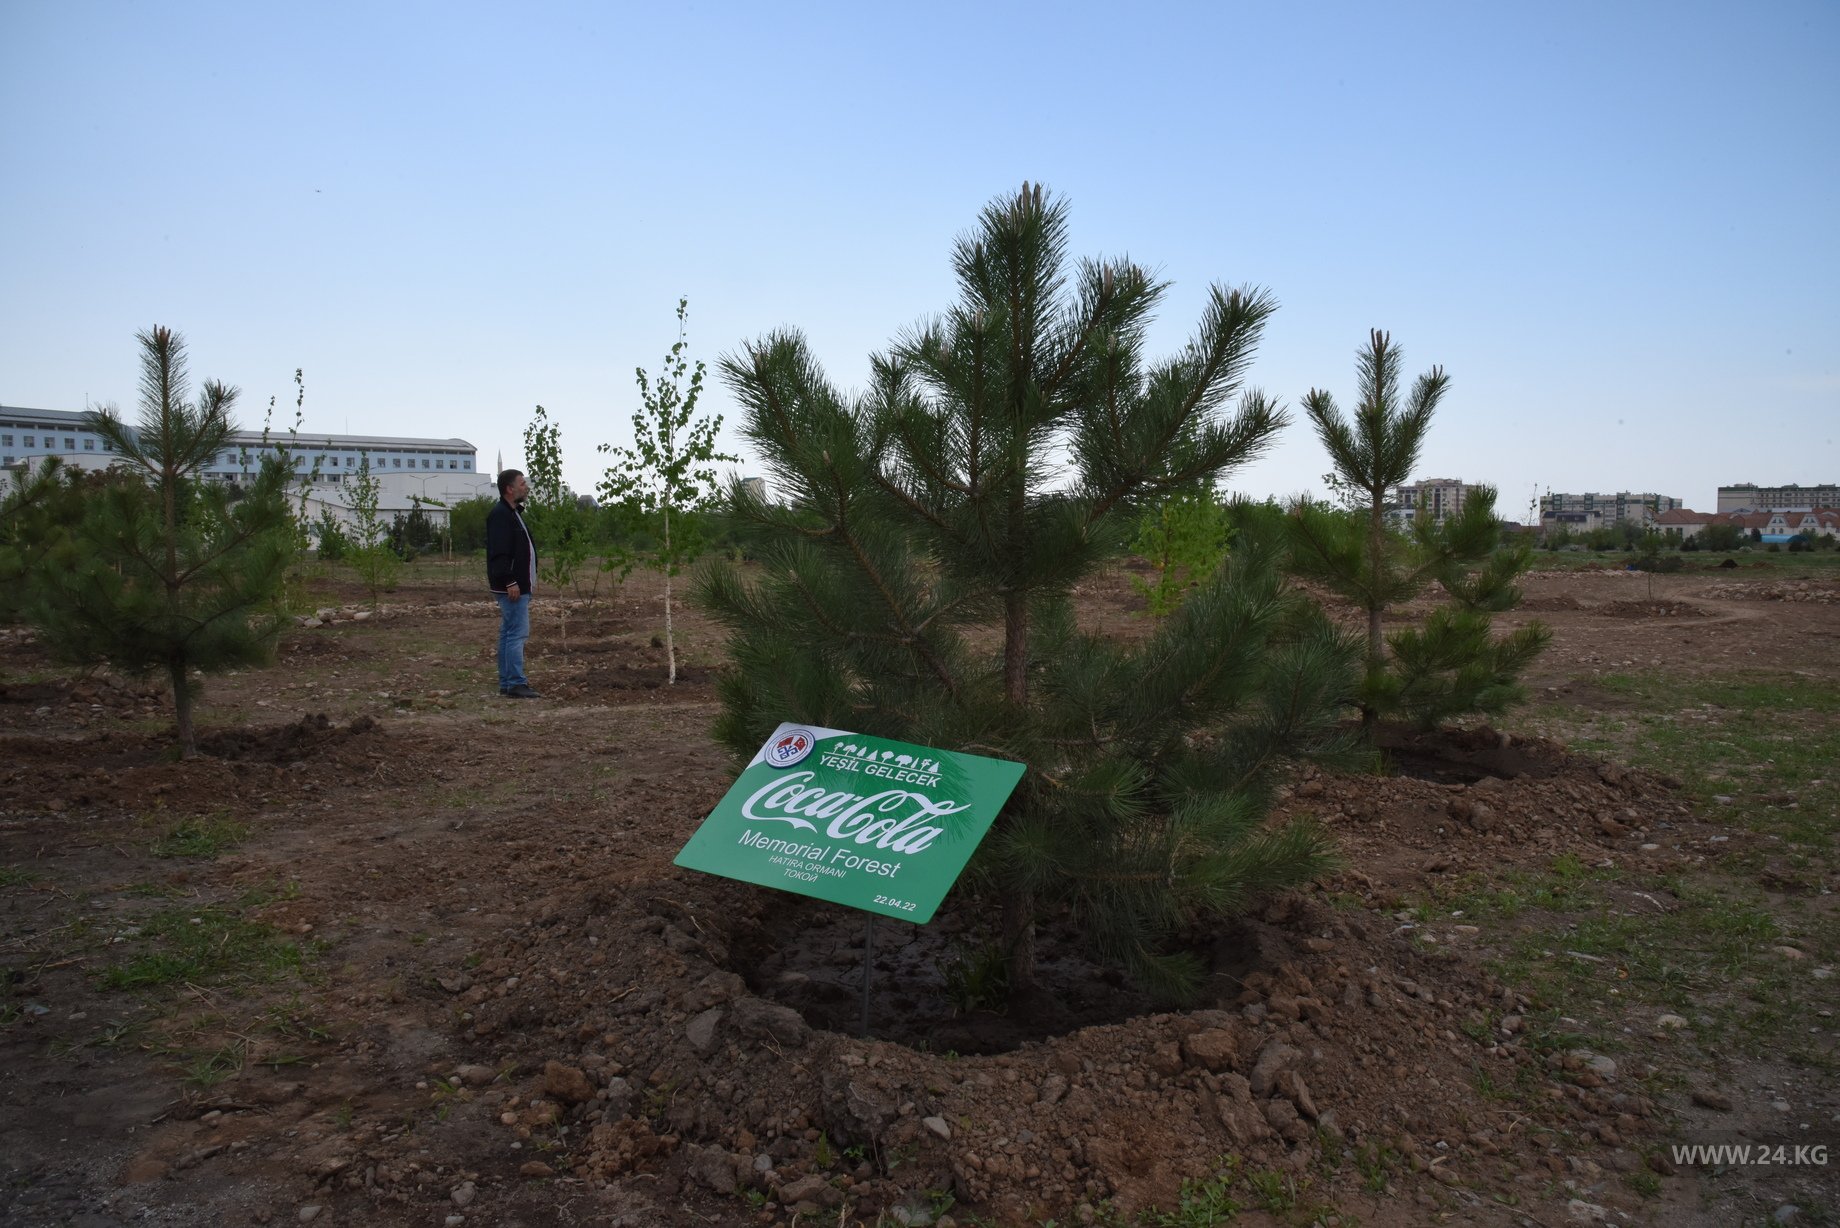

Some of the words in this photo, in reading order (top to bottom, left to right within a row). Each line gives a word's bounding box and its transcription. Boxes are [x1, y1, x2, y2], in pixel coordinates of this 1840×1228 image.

[864, 764, 943, 788] GELECEK
[738, 829, 831, 862] Memorial
[830, 848, 902, 878] Forest
[768, 855, 804, 868] HATIRA
[804, 862, 847, 879] ORMANI
[873, 894, 917, 912] 22.04.22
